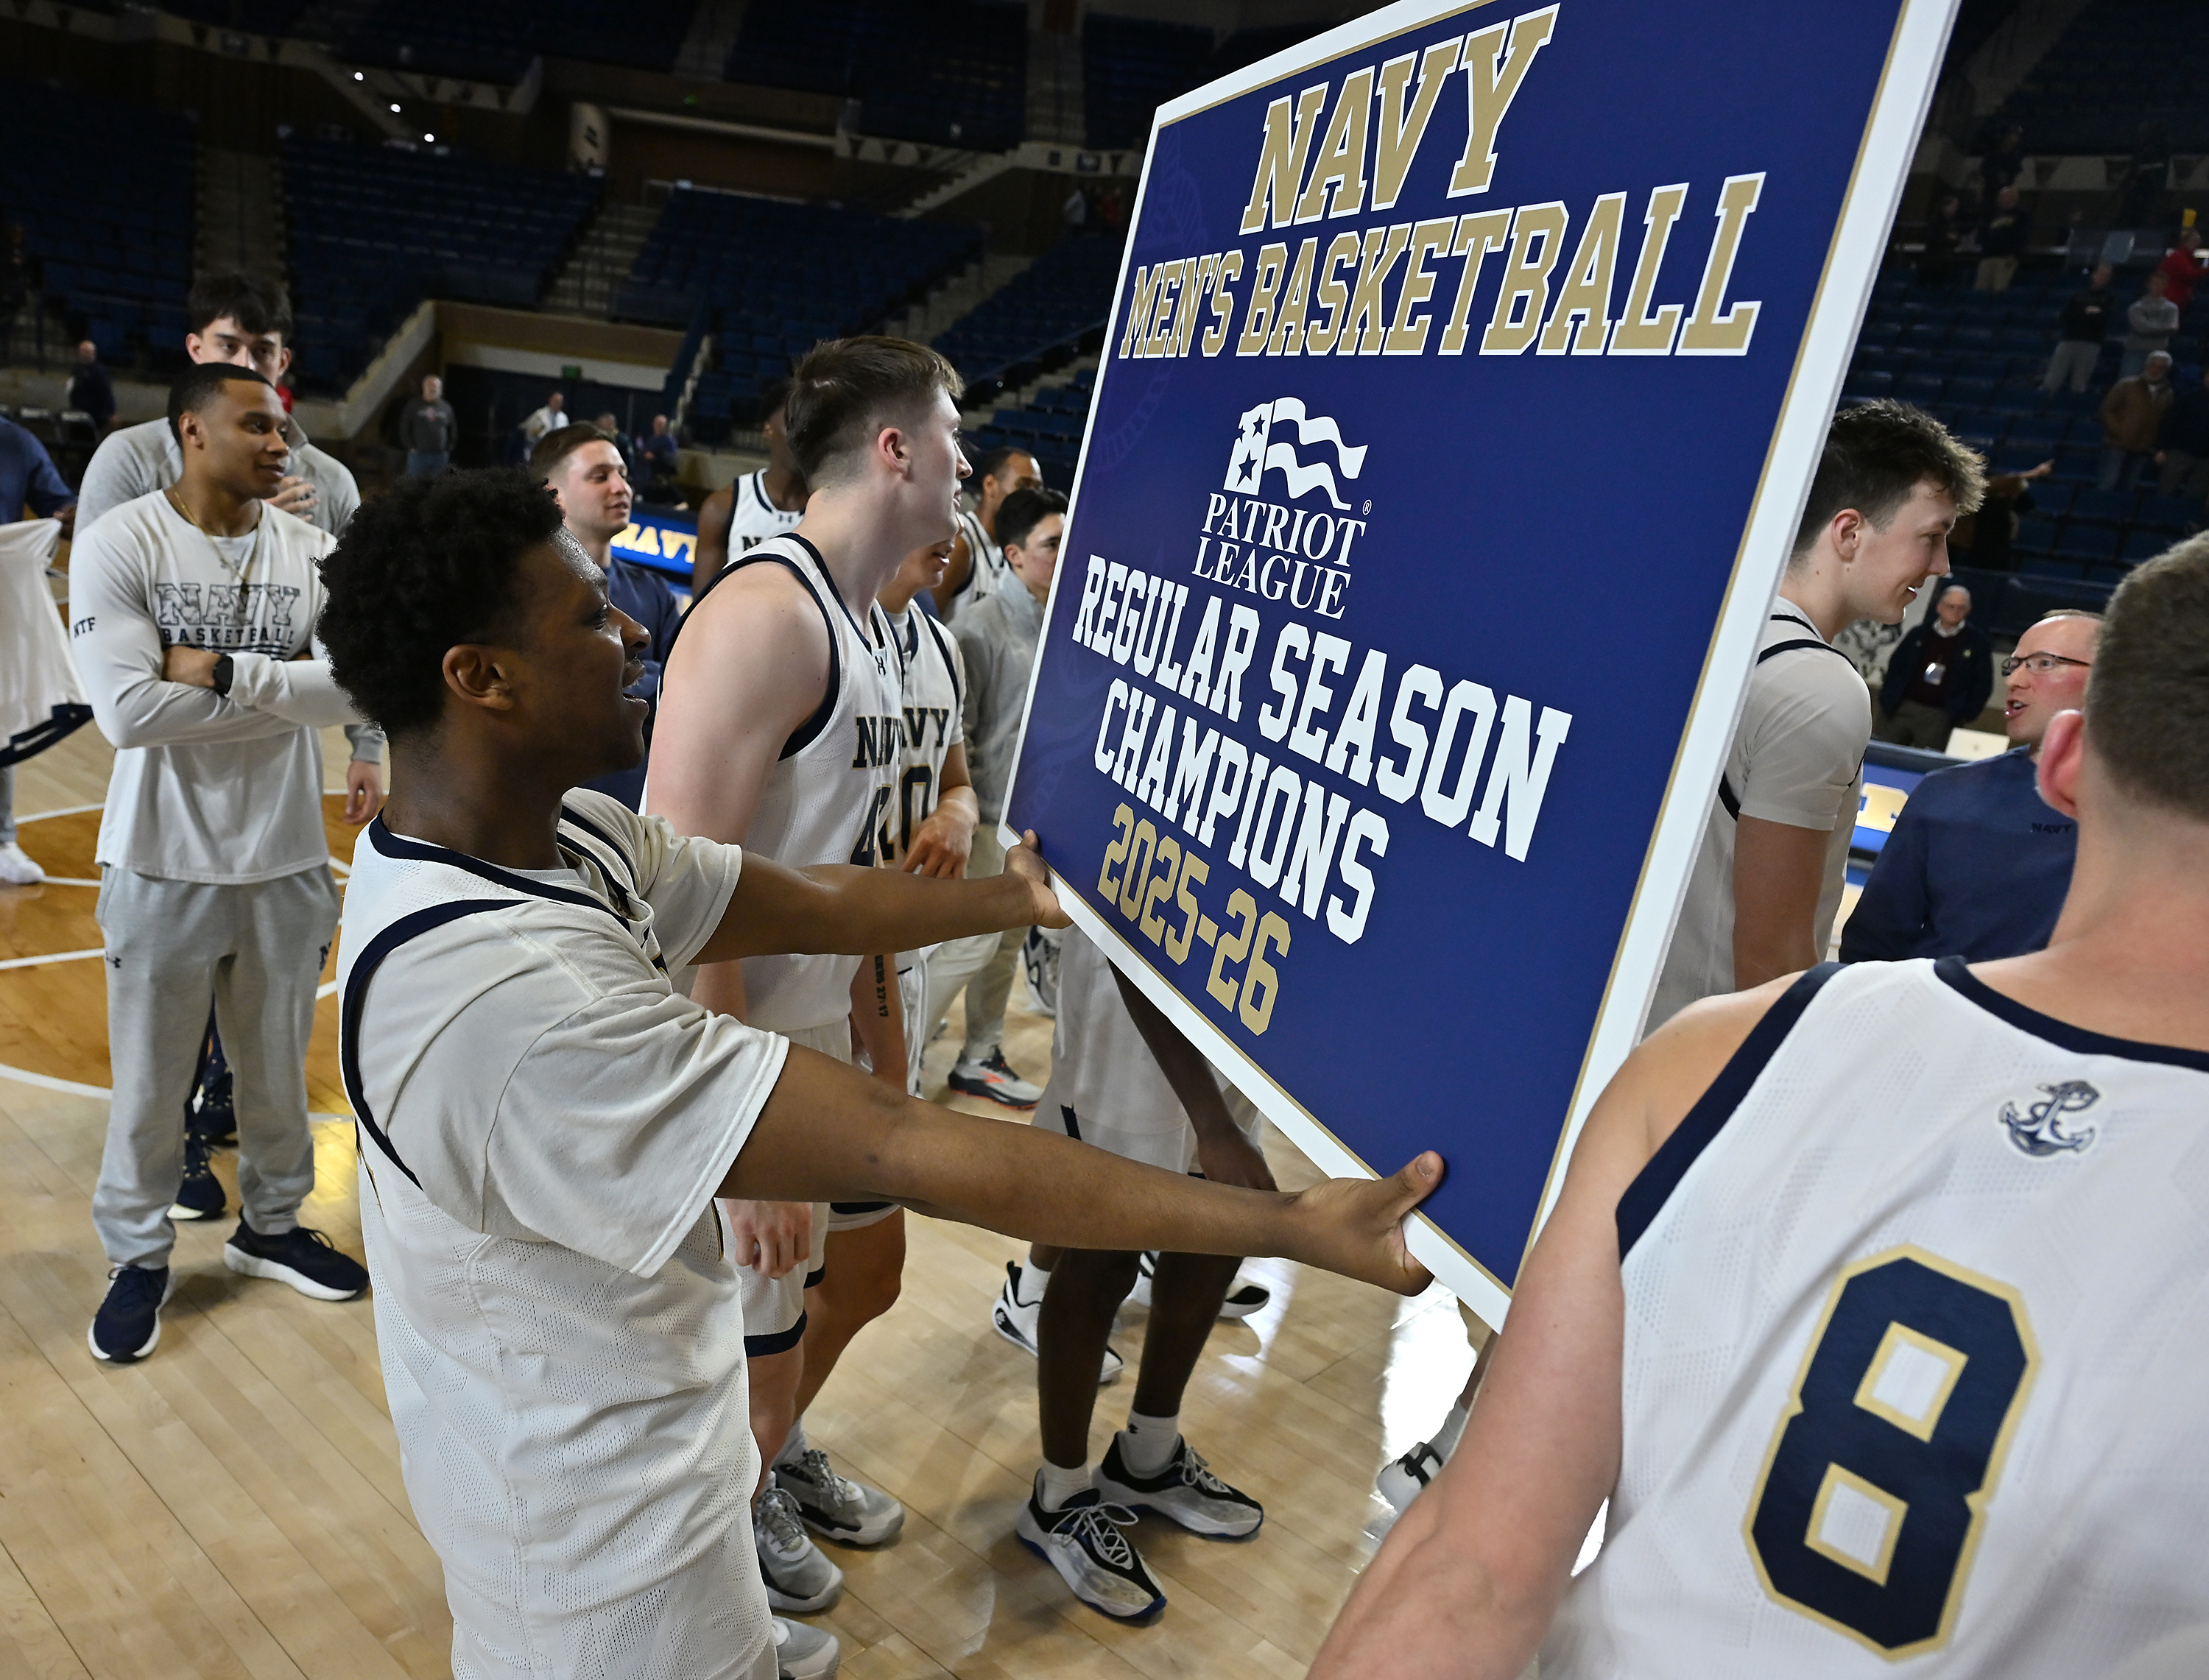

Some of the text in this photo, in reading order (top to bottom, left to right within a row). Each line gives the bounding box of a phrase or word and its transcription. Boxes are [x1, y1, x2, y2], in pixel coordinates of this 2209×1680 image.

[1239, 3, 1560, 236] NAVY
[1118, 172, 1766, 359] MEN'S BASKETBALL
[155, 582, 300, 627] NAVY
[1191, 536, 1352, 620] LEAGUE
[1202, 493, 1367, 567] PATRIOT
[162, 628, 295, 645] BASKETBALL
[1072, 554, 1573, 863] REGULAR SEASON
[1094, 677, 1389, 945] CHAMPIONS
[2032, 822, 2072, 834] NAVY
[1097, 802, 1291, 1036] 2025-26
[1742, 1243, 2040, 1662] 8
